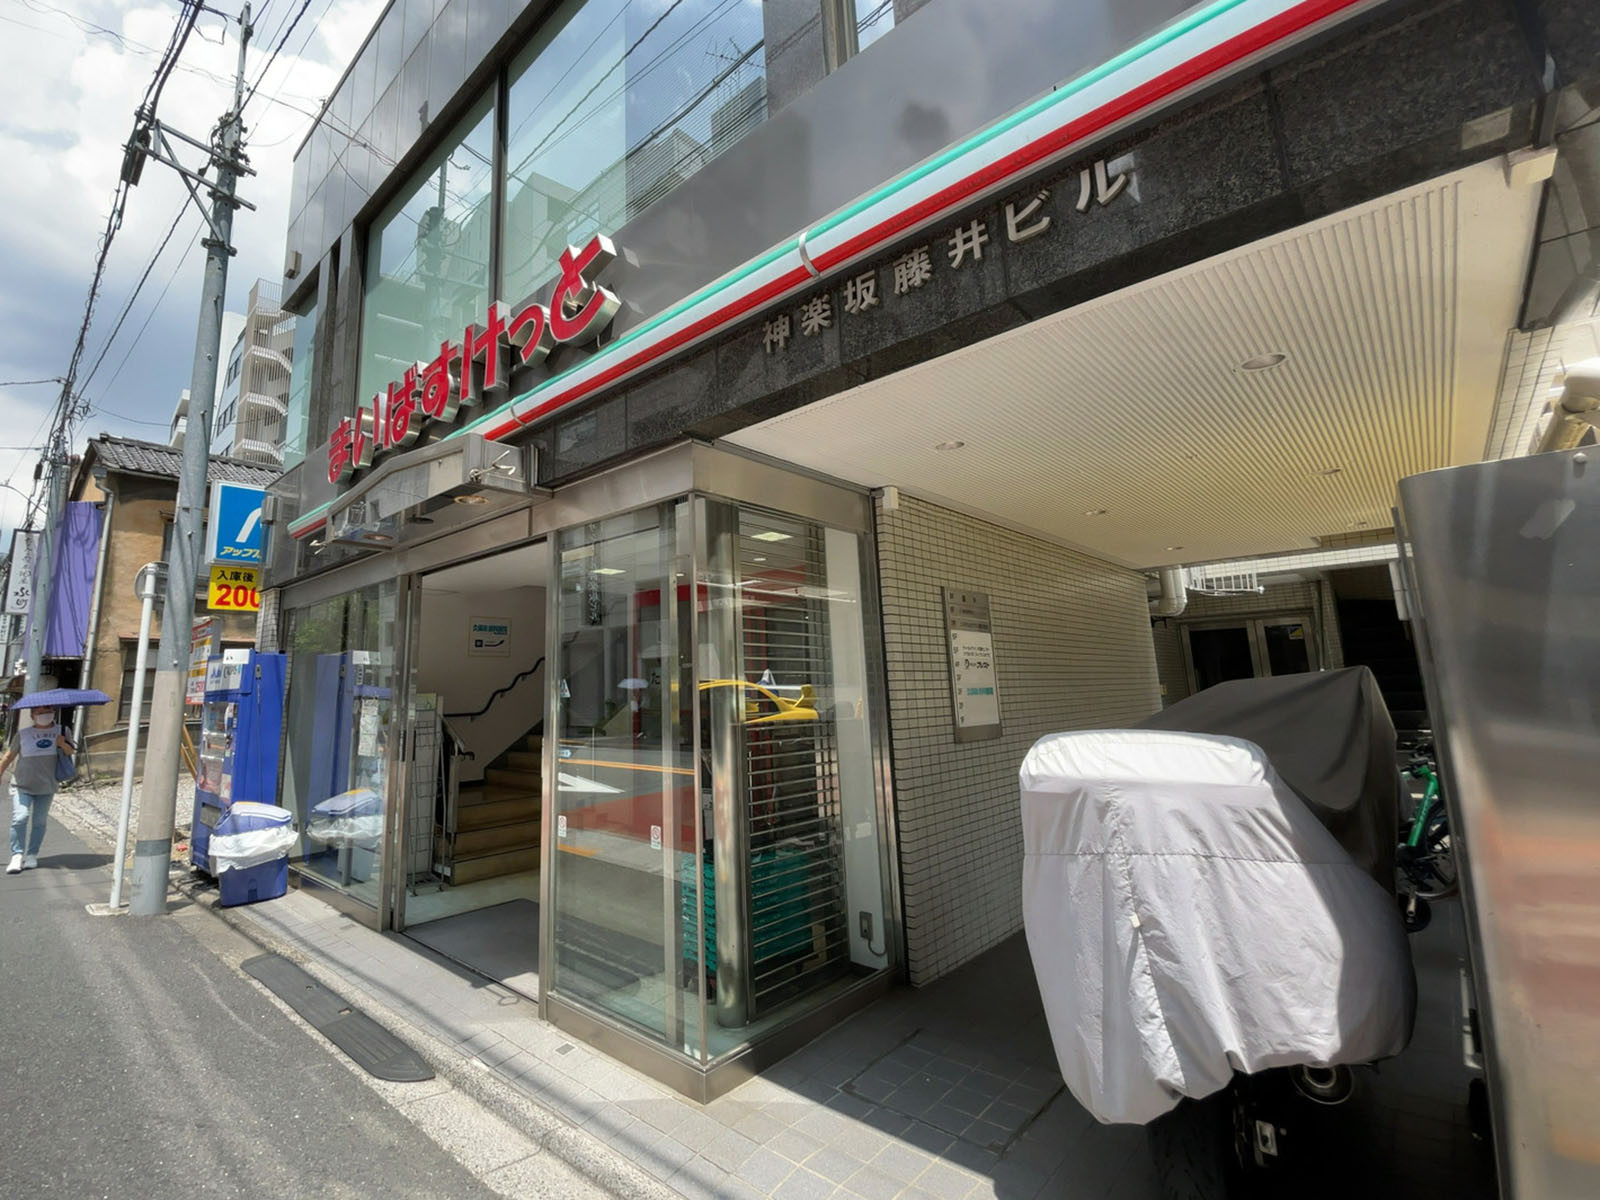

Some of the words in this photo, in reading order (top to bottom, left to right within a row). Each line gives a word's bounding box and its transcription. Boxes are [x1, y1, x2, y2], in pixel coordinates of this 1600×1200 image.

[761, 159, 1130, 353] 神楽坂藤井ビル
[328, 233, 617, 484] まいばすけっと
[217, 570, 254, 582] 入庫後
